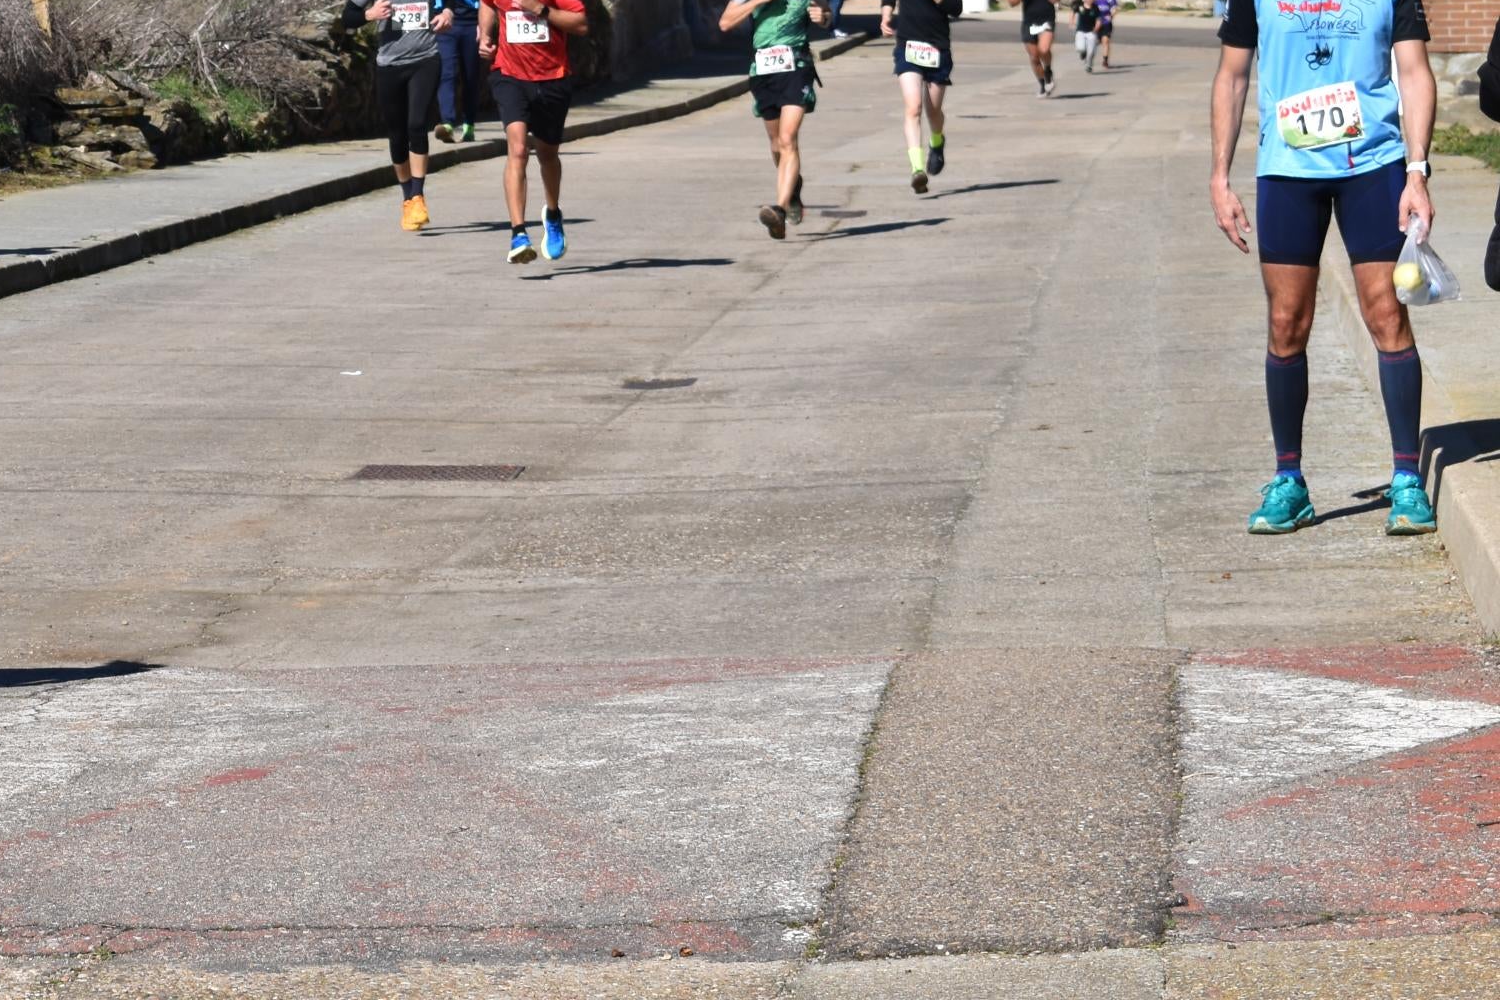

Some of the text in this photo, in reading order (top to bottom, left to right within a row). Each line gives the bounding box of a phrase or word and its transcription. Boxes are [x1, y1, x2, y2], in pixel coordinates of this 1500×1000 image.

[400, 12, 421, 23] 228
[516, 23, 538, 34] 183
[1309, 19, 1357, 31] FLOWERS
[763, 55, 785, 67] 276
[1296, 106, 1345, 136] 170
